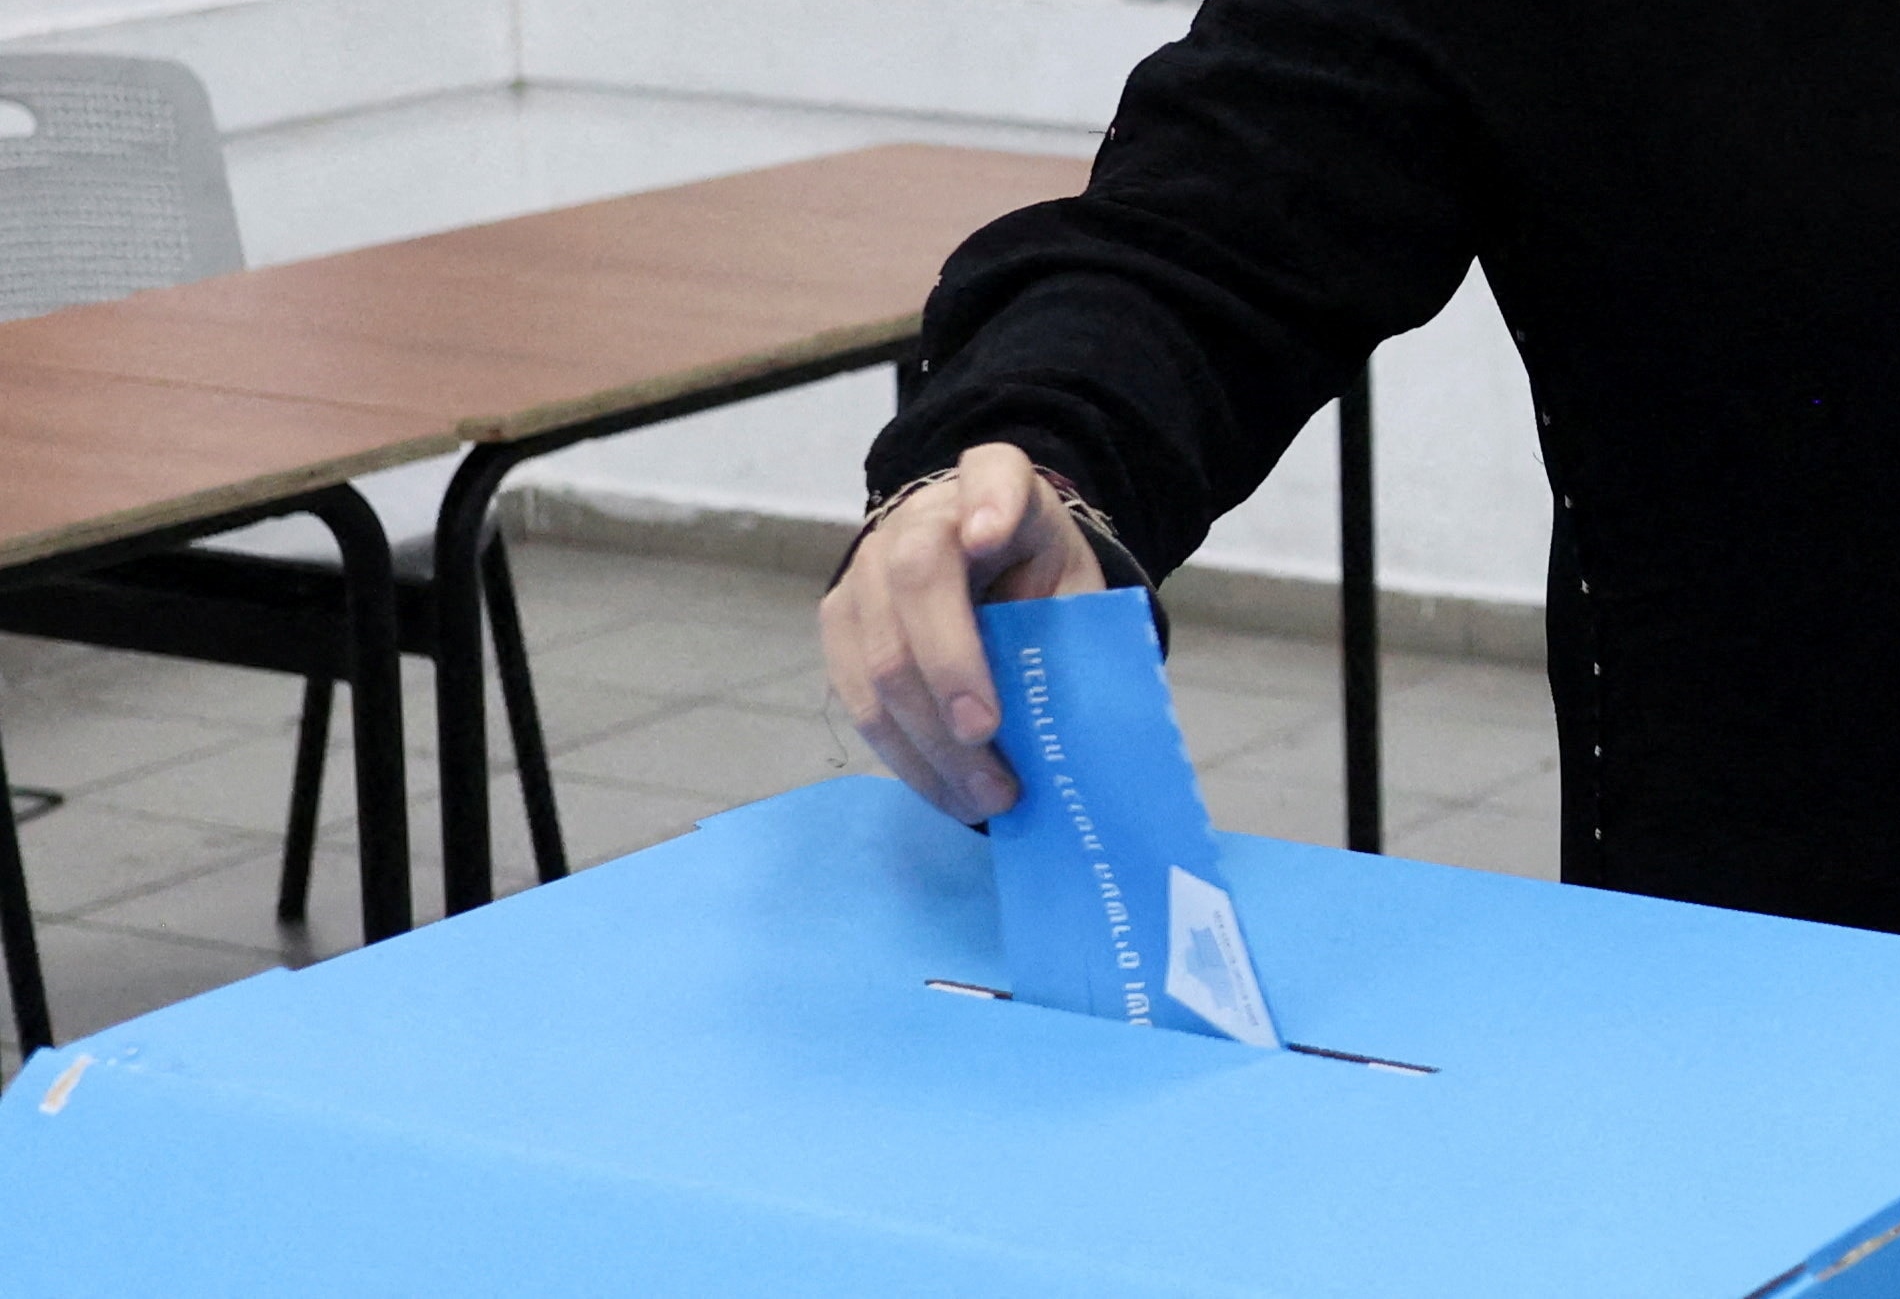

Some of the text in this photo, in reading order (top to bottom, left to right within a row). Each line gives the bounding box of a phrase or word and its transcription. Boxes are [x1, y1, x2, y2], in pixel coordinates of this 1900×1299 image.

[1019, 646, 1067, 764] הבחירות
[1052, 773, 1105, 853] לכנסת
[1093, 862, 1142, 970] העשרים
